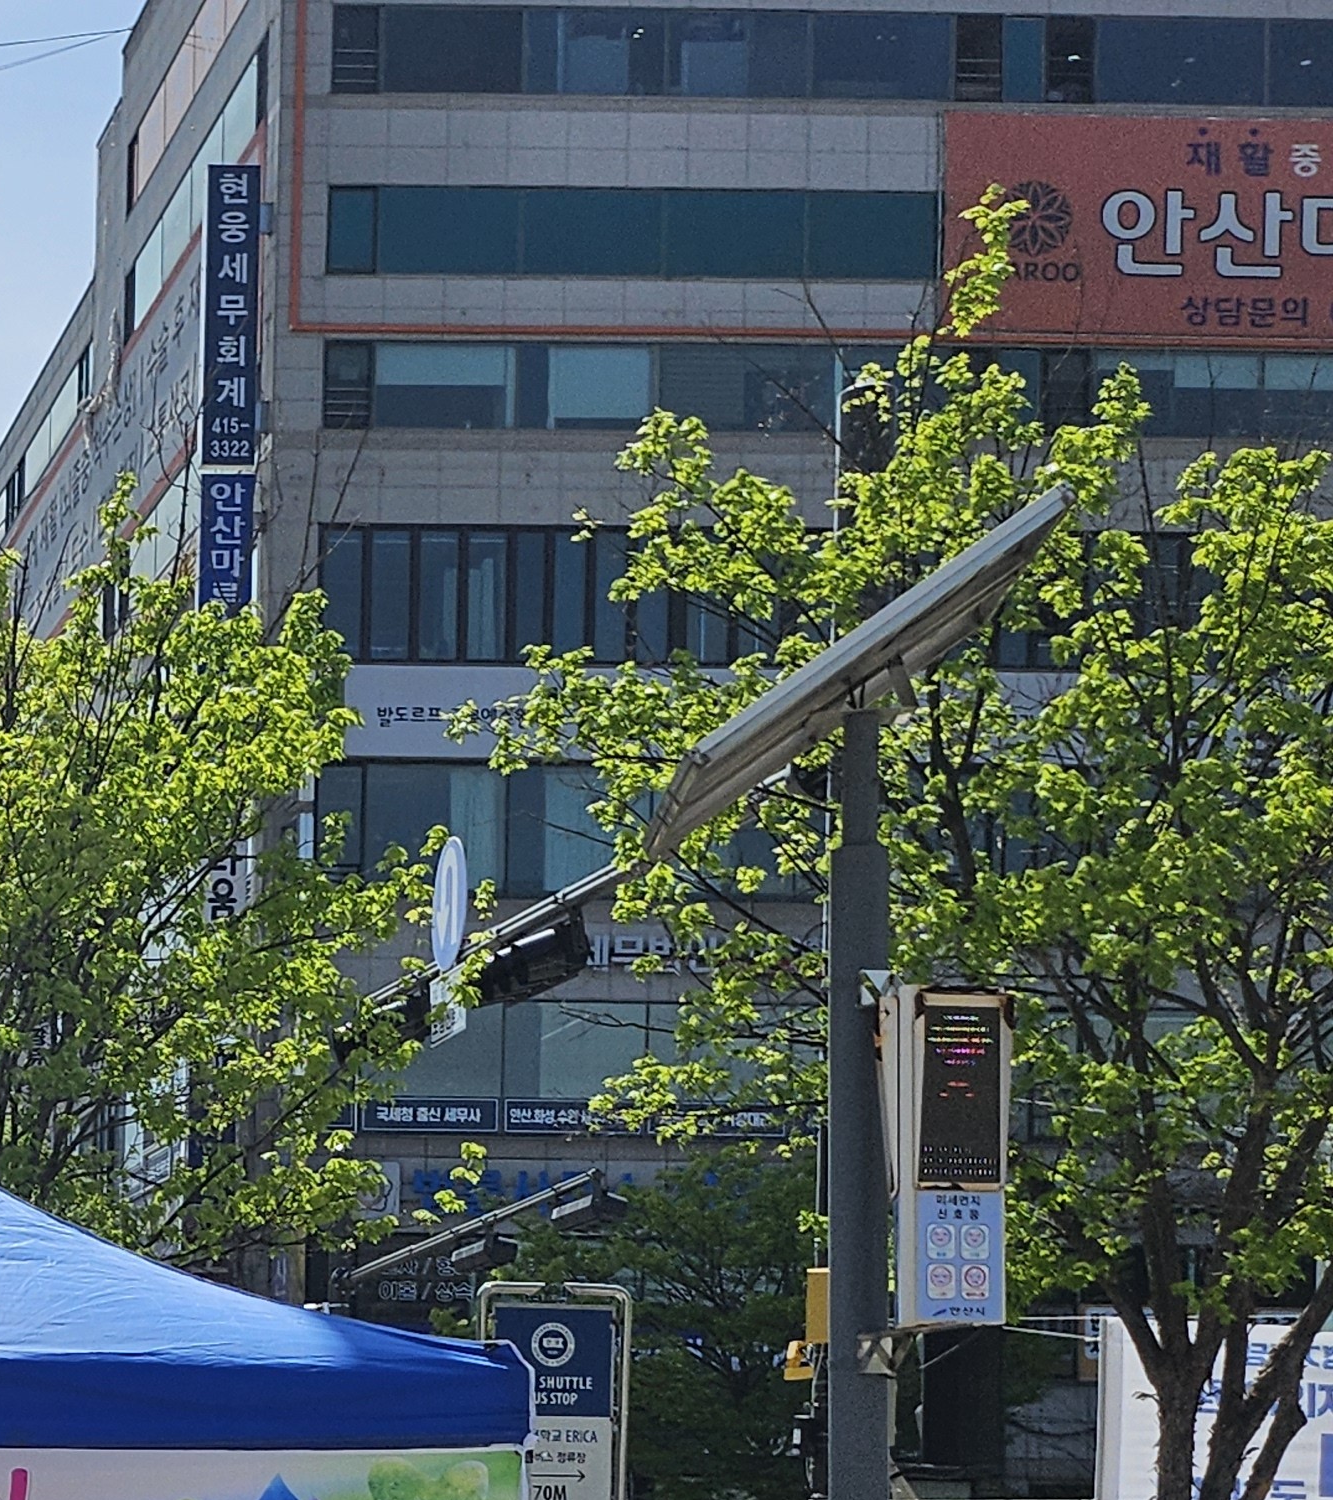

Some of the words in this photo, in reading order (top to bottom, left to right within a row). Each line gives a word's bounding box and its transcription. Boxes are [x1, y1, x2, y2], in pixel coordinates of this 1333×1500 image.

[1007, 262, 1081, 282] AROO
[217, 172, 249, 409] 현웅세무회계
[1182, 296, 1309, 328] 상담문의
[211, 417, 250, 434] 415-
[210, 440, 250, 457] 3322
[376, 1105, 413, 1123] 국세청
[416, 1106, 441, 1123] 출신
[443, 1106, 482, 1124] 세무사
[539, 1376, 593, 1390] SHUTTLE
[549, 1392, 578, 1405] STOP
[565, 1429, 598, 1443] ERICA
